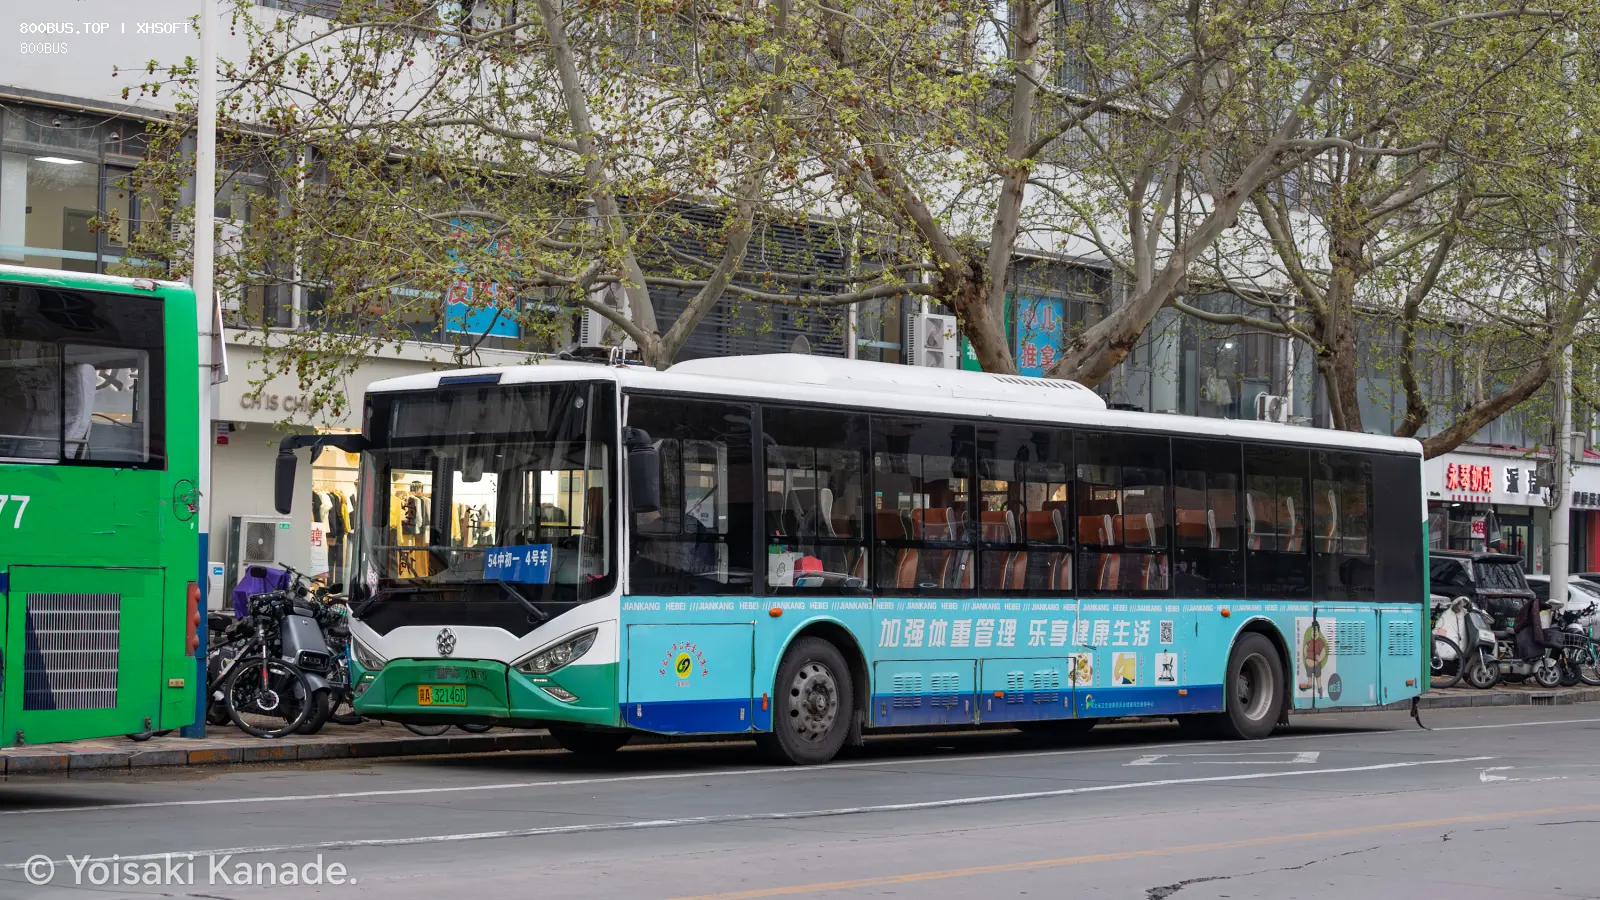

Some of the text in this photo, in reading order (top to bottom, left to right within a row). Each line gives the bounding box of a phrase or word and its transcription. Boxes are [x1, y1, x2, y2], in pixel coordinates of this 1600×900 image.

[1021, 343, 1056, 370] 推拿
[487, 549, 548, 568] 54中初一 4号车
[623, 602, 660, 611] JIANKANG
[665, 602, 686, 611] HEBEI
[739, 602, 759, 610] HEBEI
[810, 602, 828, 610] HEBEI
[876, 602, 894, 610] HEBEI
[941, 602, 958, 610] HEBEI
[1004, 602, 1020, 610] HEBEI
[878, 618, 1151, 648] 加强体重管理 乐享健康生活
